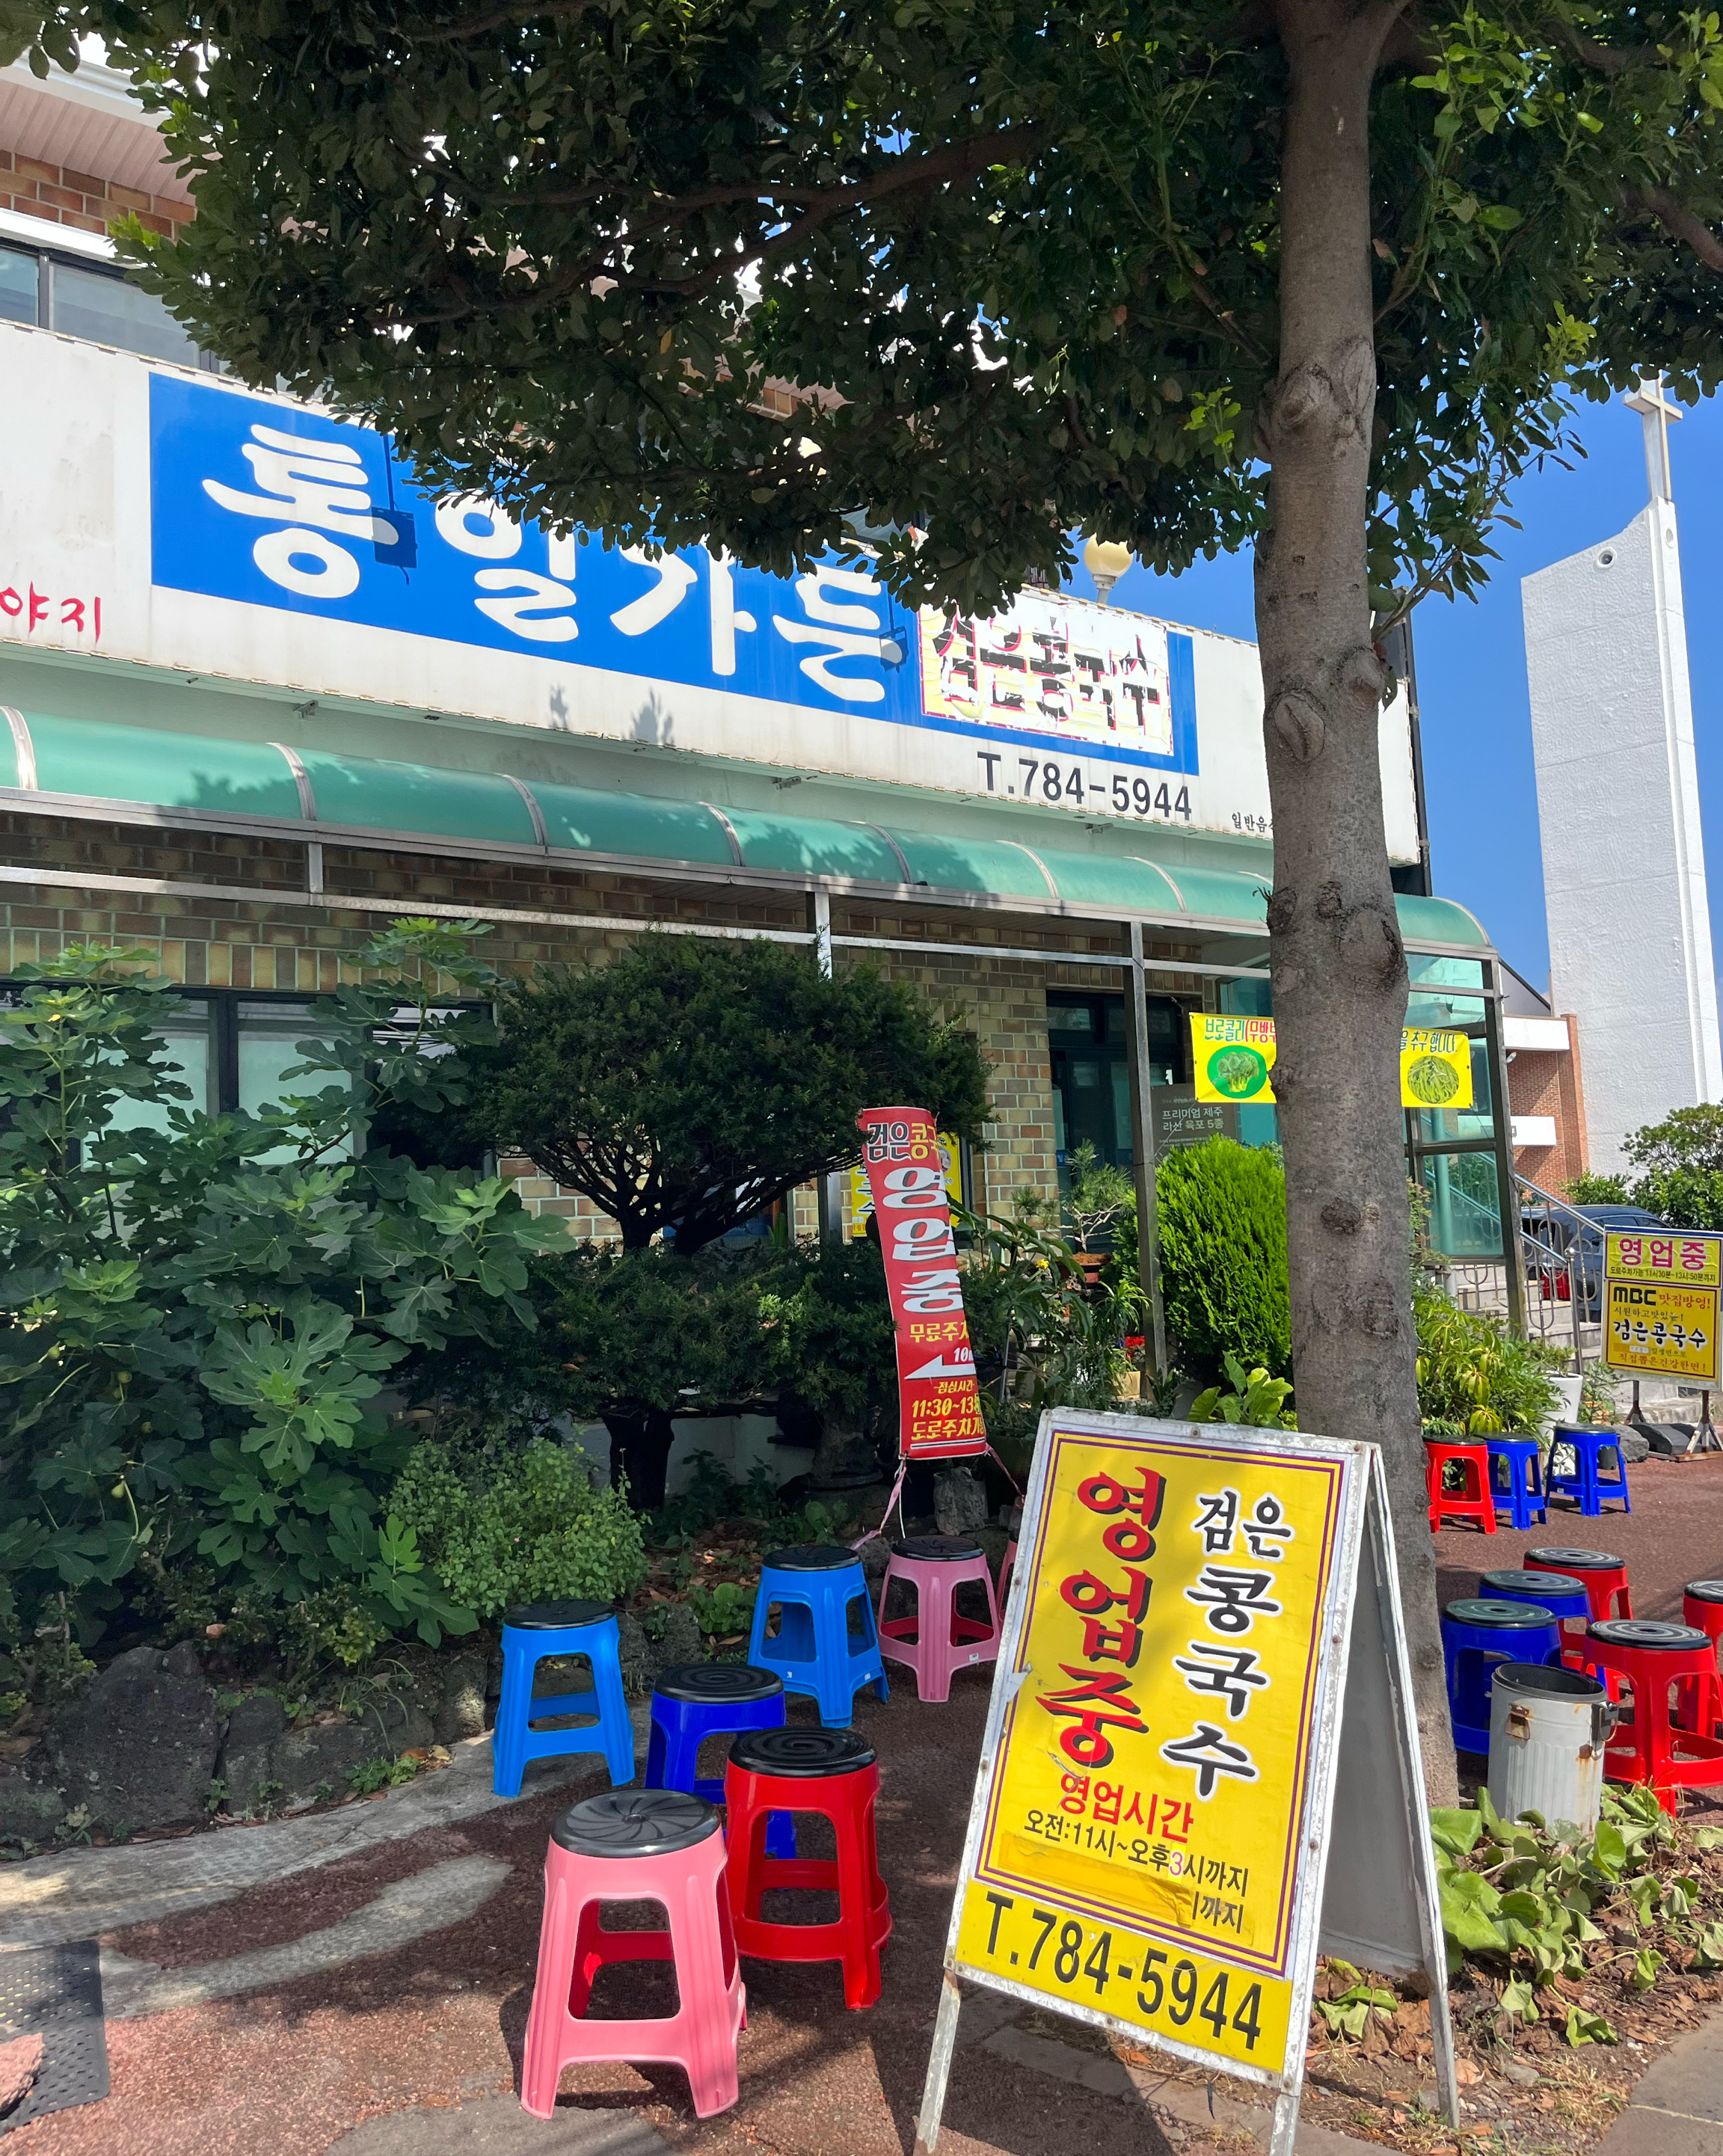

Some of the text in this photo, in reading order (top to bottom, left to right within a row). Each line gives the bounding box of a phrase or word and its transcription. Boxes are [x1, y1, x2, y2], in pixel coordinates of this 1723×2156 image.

[202, 424, 905, 703] 통일가든
[977, 751, 1191, 820] T.784-5944
[1410, 1031, 1428, 1052] 추구
[1203, 1106, 1223, 1117] 제주
[1207, 1118, 1223, 1129] 5종
[882, 1167, 964, 1314] 영업중
[1619, 1238, 1707, 1271] 영업중
[1610, 1266, 1644, 1277] 도로주차가능
[1613, 1286, 1710, 1309] MBC 맛집방영!
[1612, 1318, 1707, 1349] 검은콩국수
[1036, 1466, 1167, 1769] 영업중
[1060, 1772, 1194, 1843] 영업시간
[986, 1891, 1263, 2051] T.784-5944
